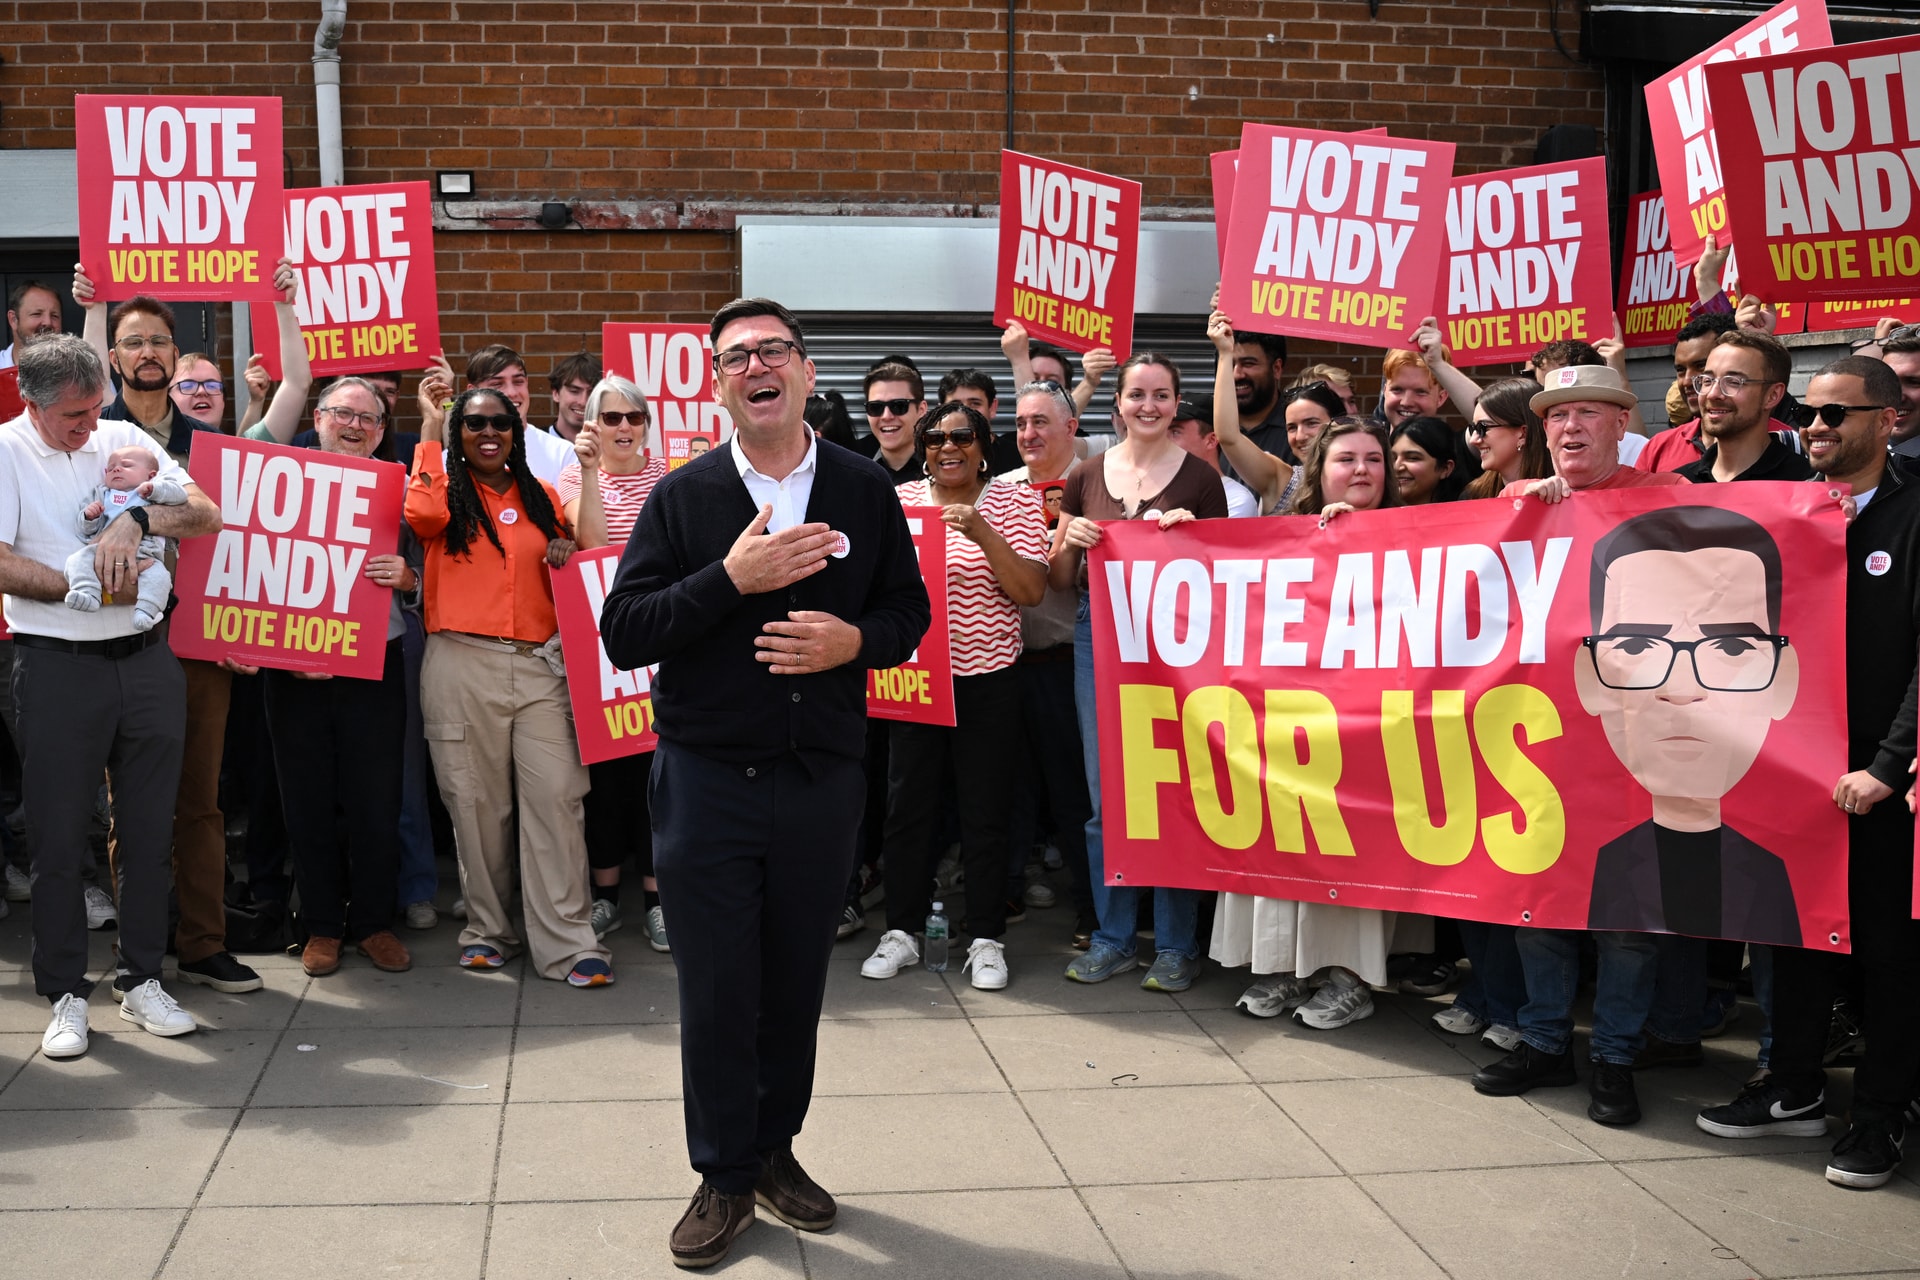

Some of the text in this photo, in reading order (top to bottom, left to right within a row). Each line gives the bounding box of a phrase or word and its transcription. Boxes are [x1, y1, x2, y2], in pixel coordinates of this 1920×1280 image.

[105, 106, 257, 177] VOTE
[1270, 136, 1427, 222] VOTE
[1764, 147, 1920, 237] AND
[108, 181, 255, 244] ANDY
[1019, 164, 1120, 252] VOTE
[1445, 170, 1582, 252] VOTE
[109, 250, 259, 283] VOTE HOPE
[1014, 229, 1116, 309] ANDY
[1254, 211, 1415, 290] ANDY
[1768, 239, 1861, 282] VOTE
[1868, 235, 1920, 277] HO
[1447, 241, 1581, 315] ANDY
[1013, 287, 1058, 328] VOTE
[1062, 303, 1113, 346] HOPE
[1252, 280, 1407, 331] VOTE HOPE
[1448, 307, 1587, 351] VOTE HOPE
[1625, 301, 1691, 335] VOTE HOPE
[303, 328, 347, 361] OTE
[352, 323, 418, 357] HOPE
[1561, 370, 1575, 378] VOTE
[669, 437, 689, 448] VOTE
[669, 448, 689, 458] ANDY
[220, 448, 377, 545] VOTE
[205, 530, 367, 614] ANDY
[1869, 563, 1886, 571] ANDY
[1870, 555, 1888, 564] VOTE
[1104, 536, 1574, 669] VOTE ANDY
[203, 603, 361, 657] VOTE HOPE
[873, 668, 932, 705] HOPE
[603, 698, 656, 740] VOT
[1119, 683, 1566, 875] FOR US
